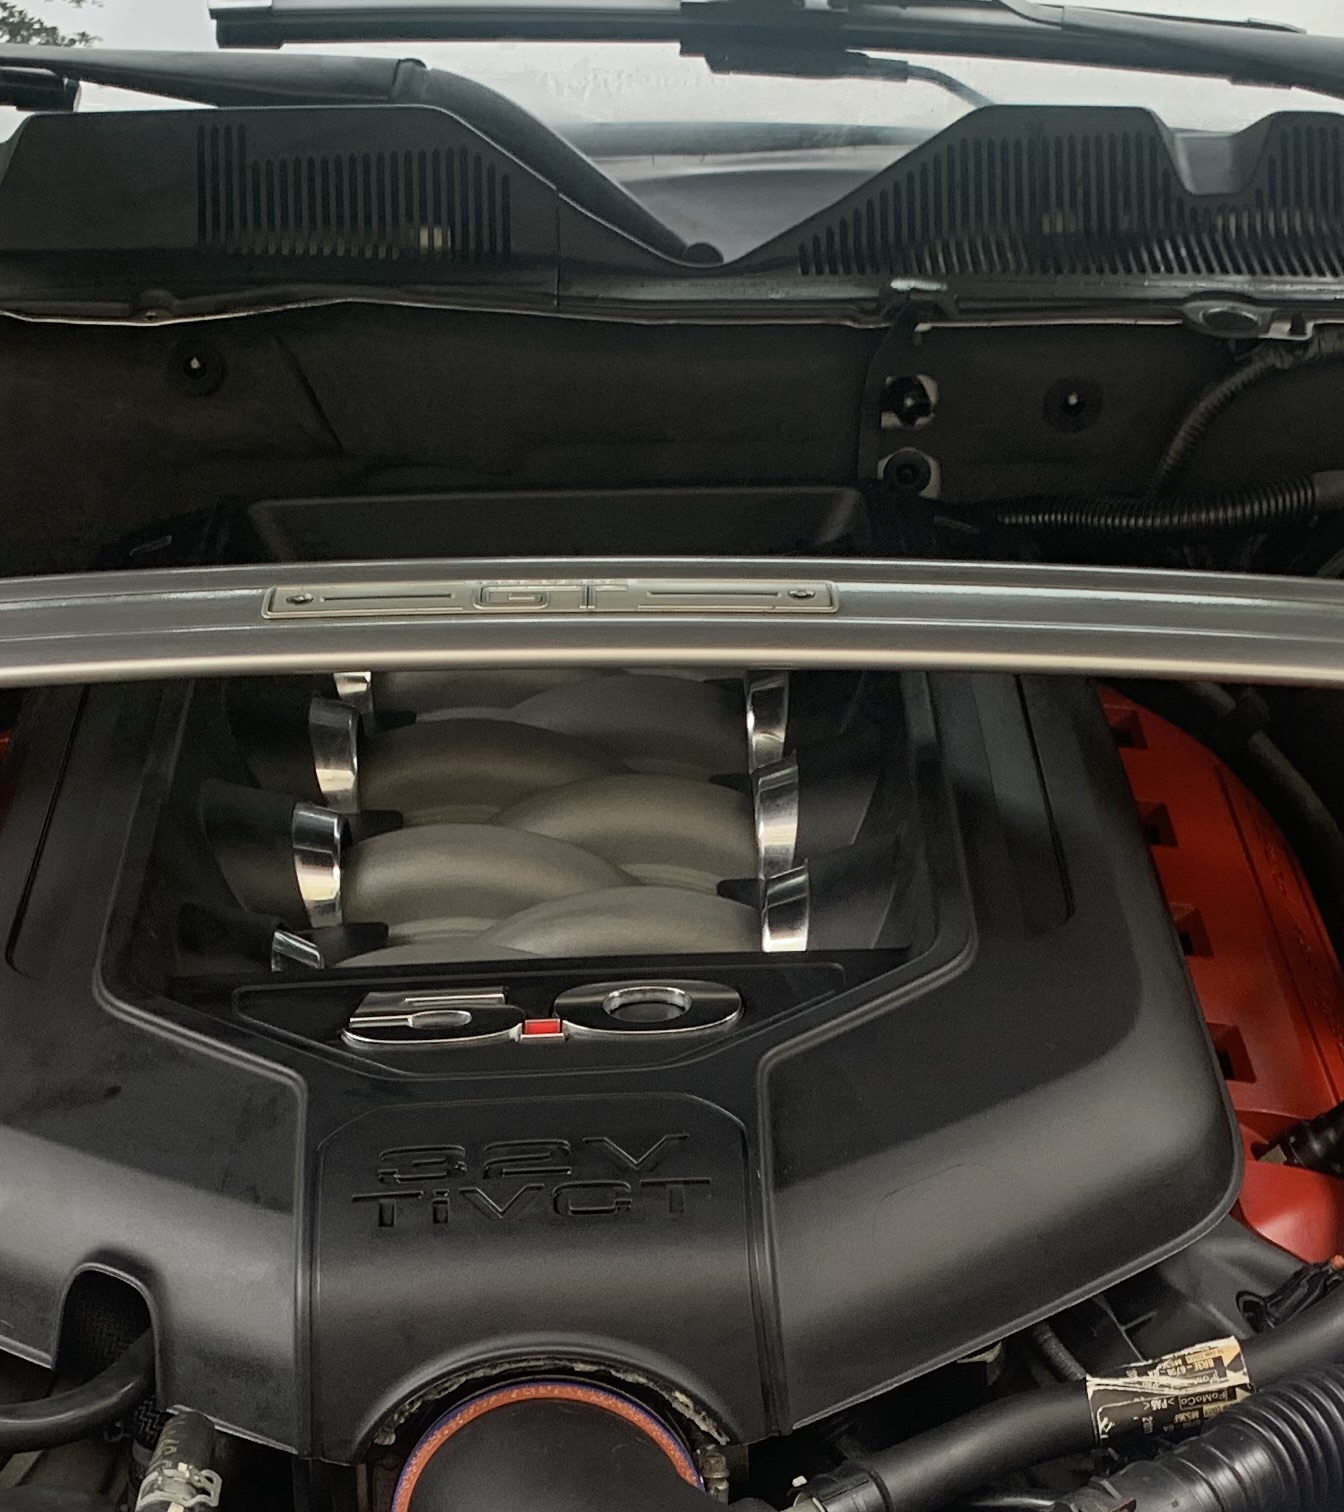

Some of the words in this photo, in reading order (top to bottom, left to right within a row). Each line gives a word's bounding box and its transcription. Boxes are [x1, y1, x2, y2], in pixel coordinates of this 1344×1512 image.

[342, 979, 743, 1046] 5.0
[378, 1133, 690, 1184] 32V
[1180, 1390, 1228, 1407] FoMoCo
